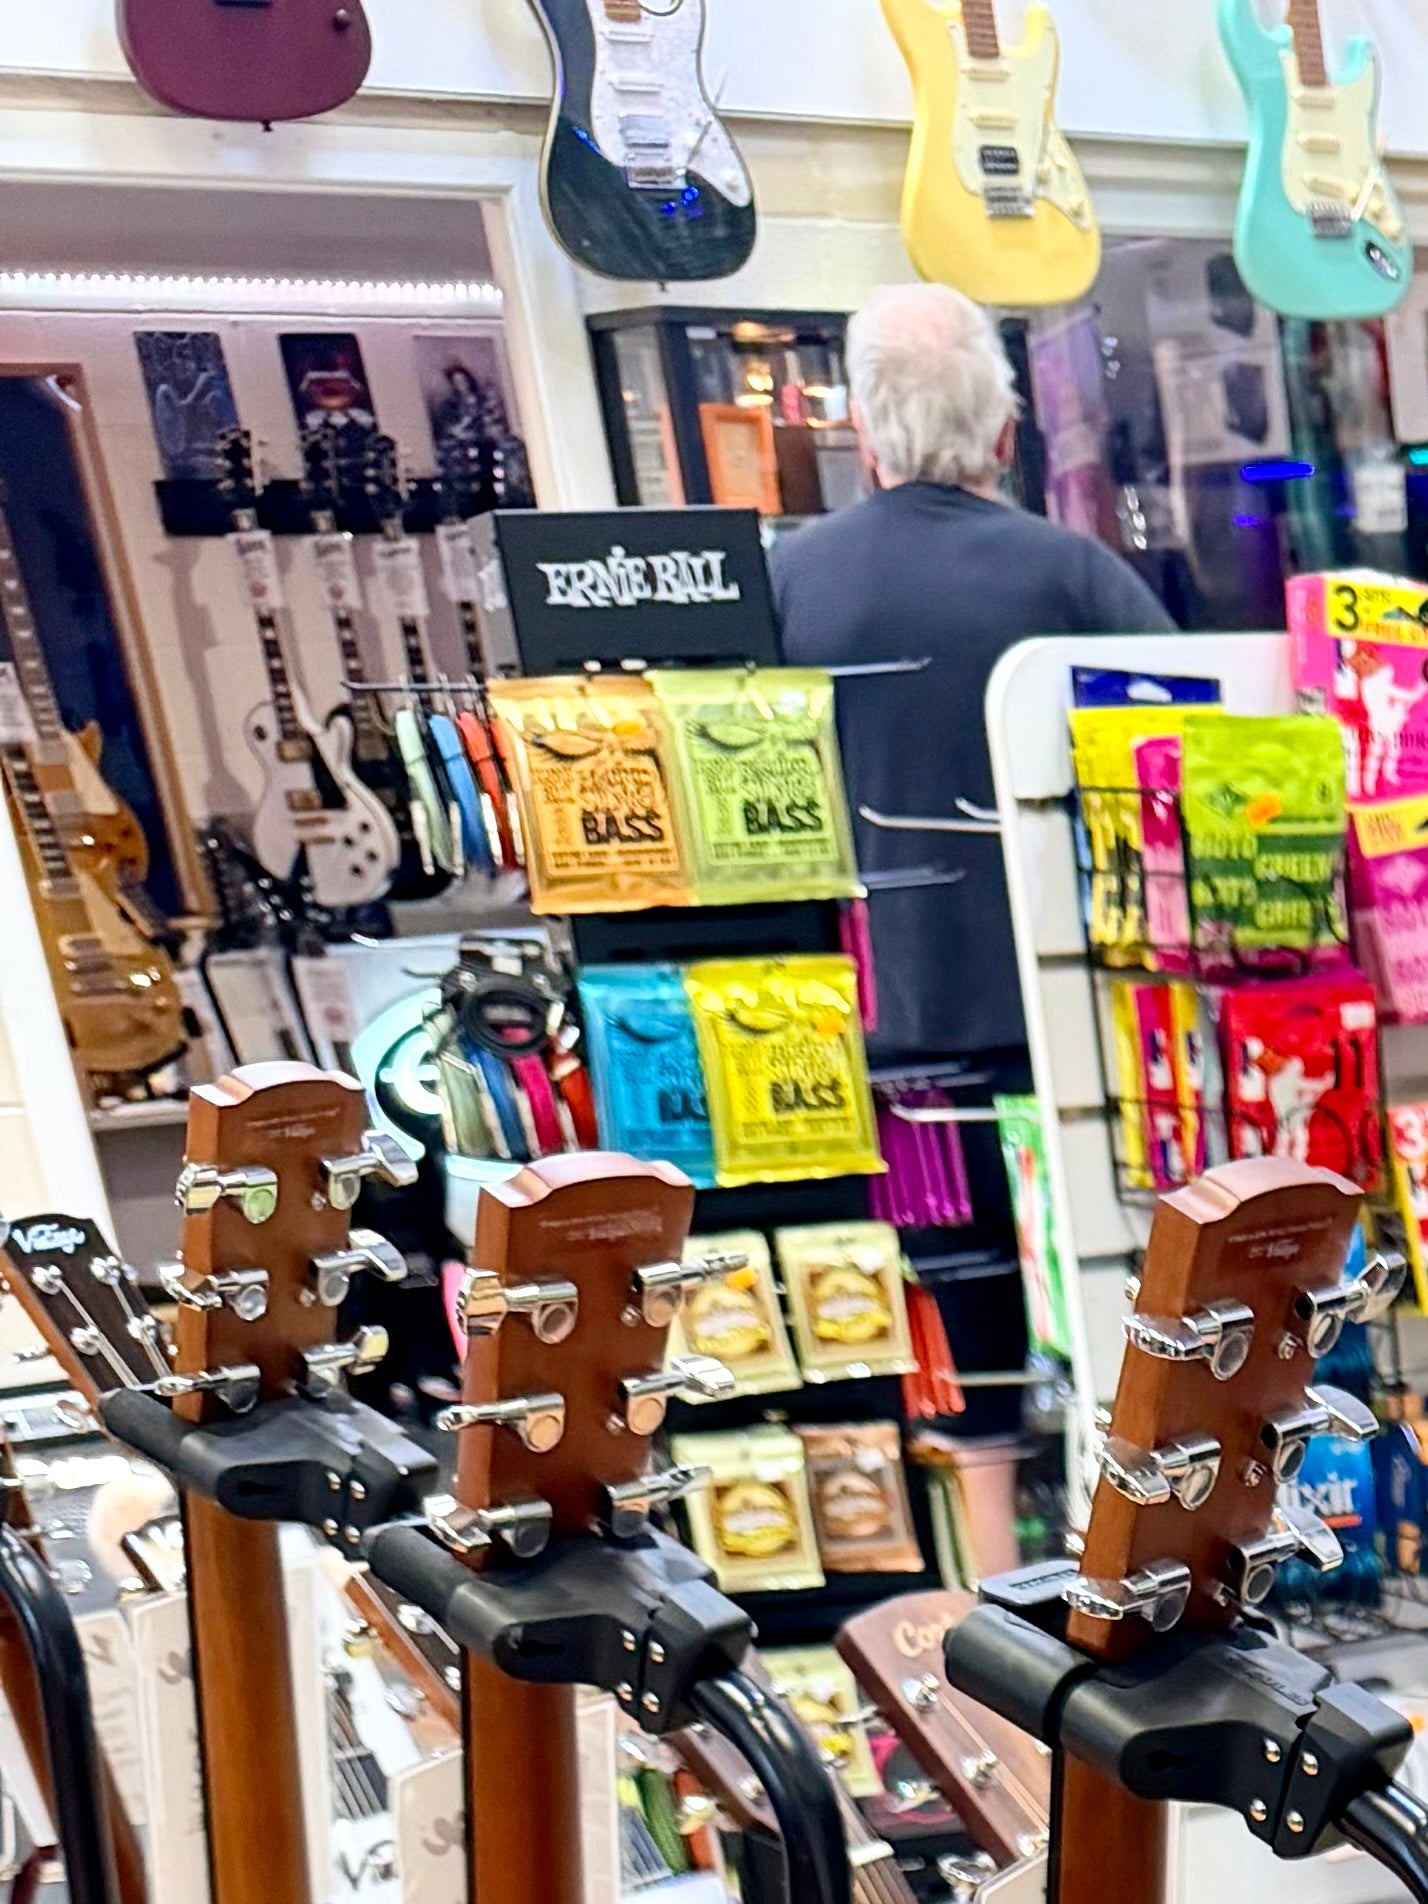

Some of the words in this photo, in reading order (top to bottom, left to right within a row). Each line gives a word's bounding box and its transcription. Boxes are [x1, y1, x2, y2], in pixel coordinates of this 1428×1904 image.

[537, 545, 650, 608] ERNIE
[649, 550, 741, 605] BALL
[1335, 585, 1360, 633] 3
[581, 806, 667, 848] BASS
[742, 797, 826, 838] BASS
[1332, 1036, 1364, 1092] 11
[770, 1076, 848, 1114] BASS
[894, 1612, 951, 1657] Cor
